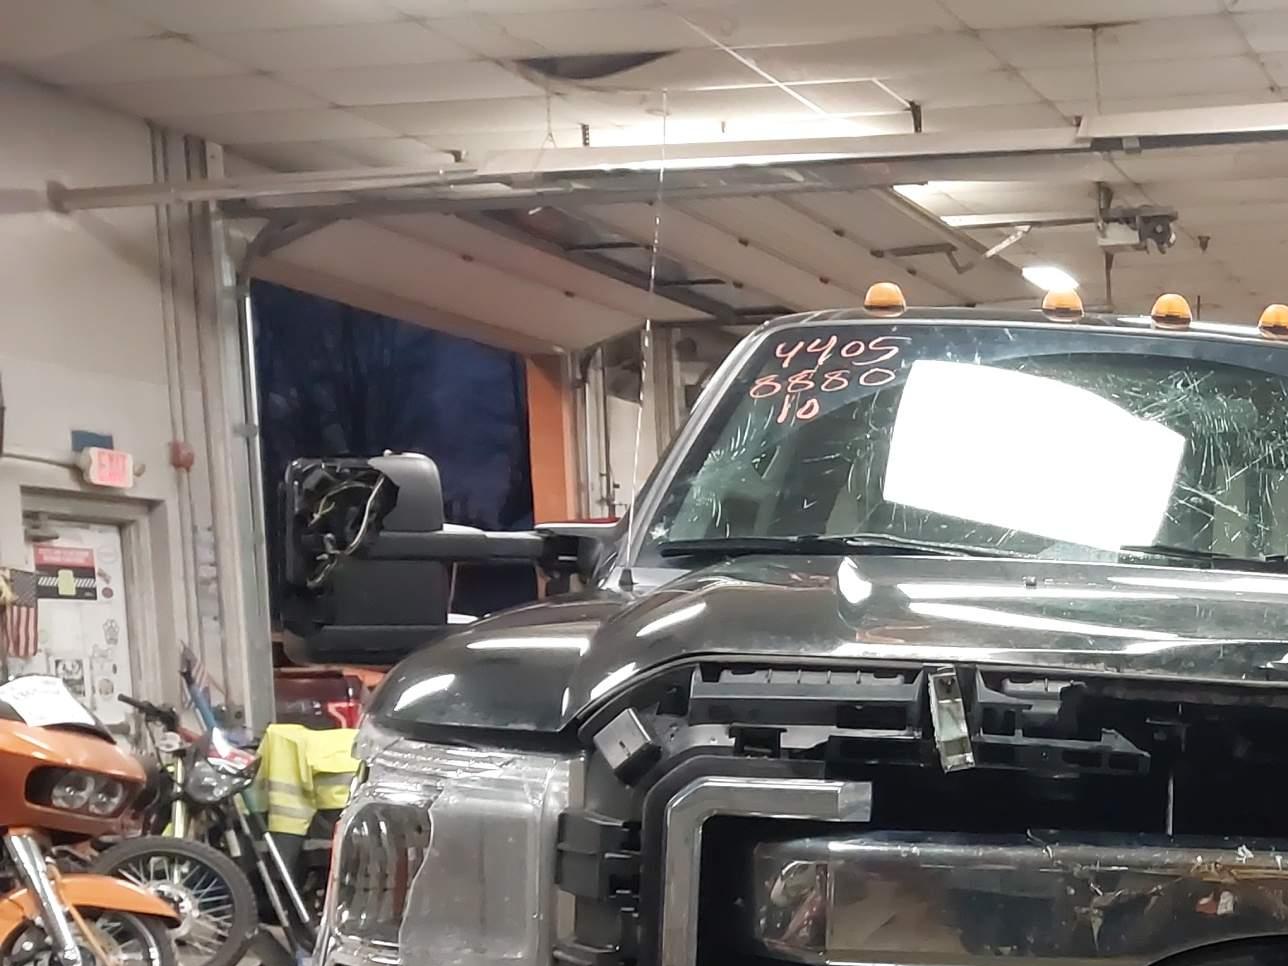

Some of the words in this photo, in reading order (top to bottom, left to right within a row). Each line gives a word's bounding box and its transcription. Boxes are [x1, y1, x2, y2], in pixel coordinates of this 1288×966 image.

[775, 335, 912, 368] 4405
[750, 367, 897, 398] 8880
[776, 394, 820, 424] 10
